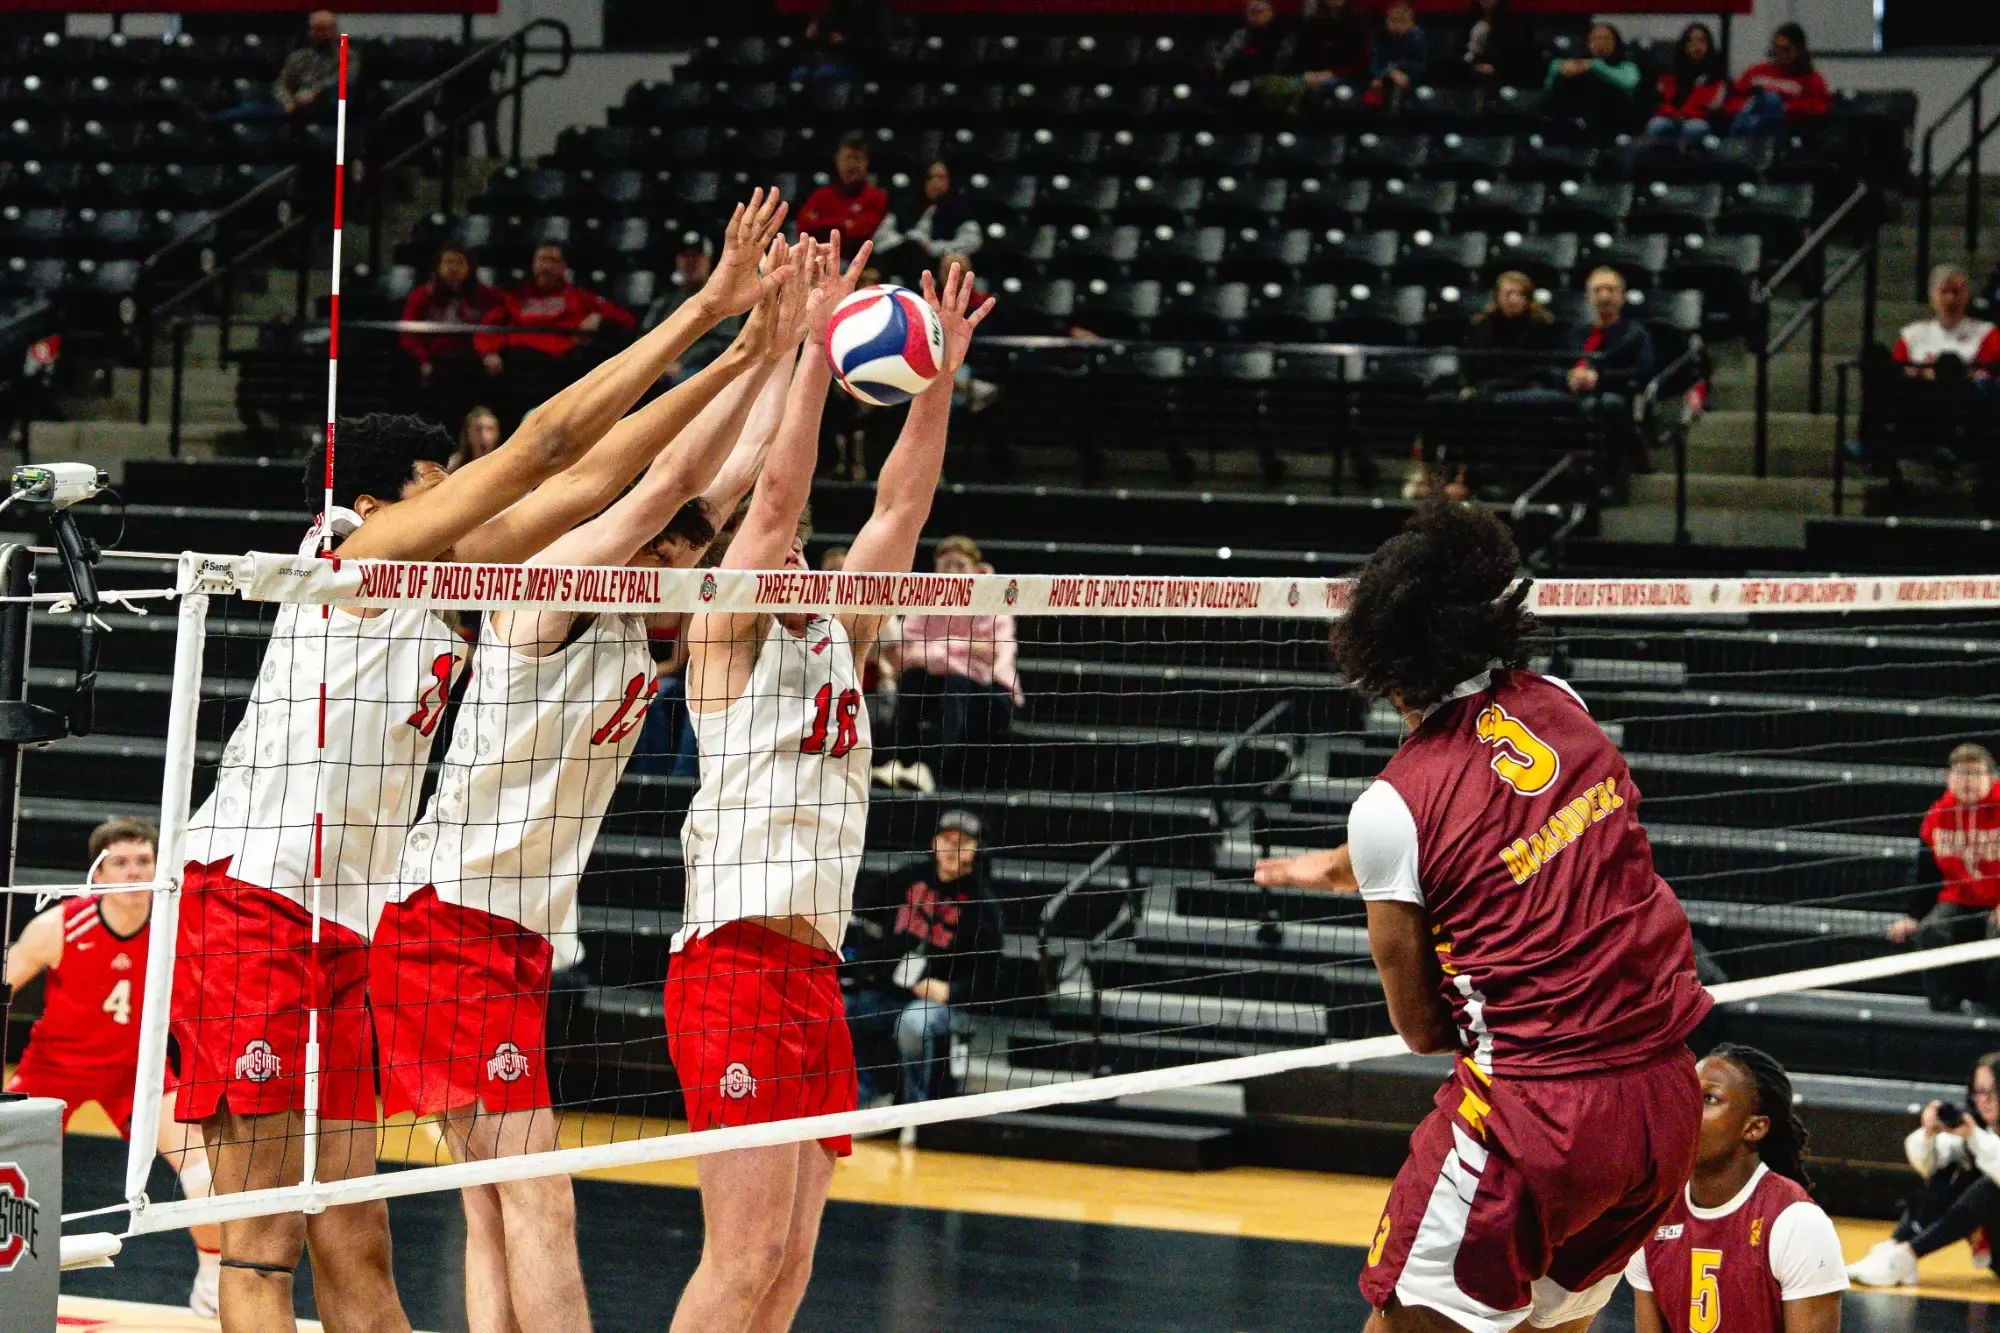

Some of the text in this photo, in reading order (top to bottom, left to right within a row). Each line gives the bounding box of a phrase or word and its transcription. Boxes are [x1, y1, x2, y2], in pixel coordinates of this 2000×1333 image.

[355, 564, 405, 598] HOME
[408, 564, 429, 599] OF
[431, 565, 473, 600] OHIO
[474, 566, 523, 601] STATE
[523, 568, 573, 601] MEN'S
[575, 569, 661, 604] VOLLEYBALL
[755, 573, 833, 605] THREE-TIME
[835, 575, 895, 606] NATIONAL
[899, 576, 975, 607] CHAMPIONS
[1048, 578, 1084, 606] HOME
[1084, 579, 1099, 607] OF
[1101, 579, 1130, 607] OHIO
[1131, 580, 1165, 607] STATE
[1165, 580, 1199, 608] MEN'S
[1200, 580, 1261, 608] VOLLEYBALL
[800, 682, 861, 760] 18
[102, 979, 132, 1026] 4
[235, 1050, 282, 1080] OHIO STATE
[487, 1053, 530, 1081] OHIO STATE
[1688, 1248, 1723, 1333] 5
